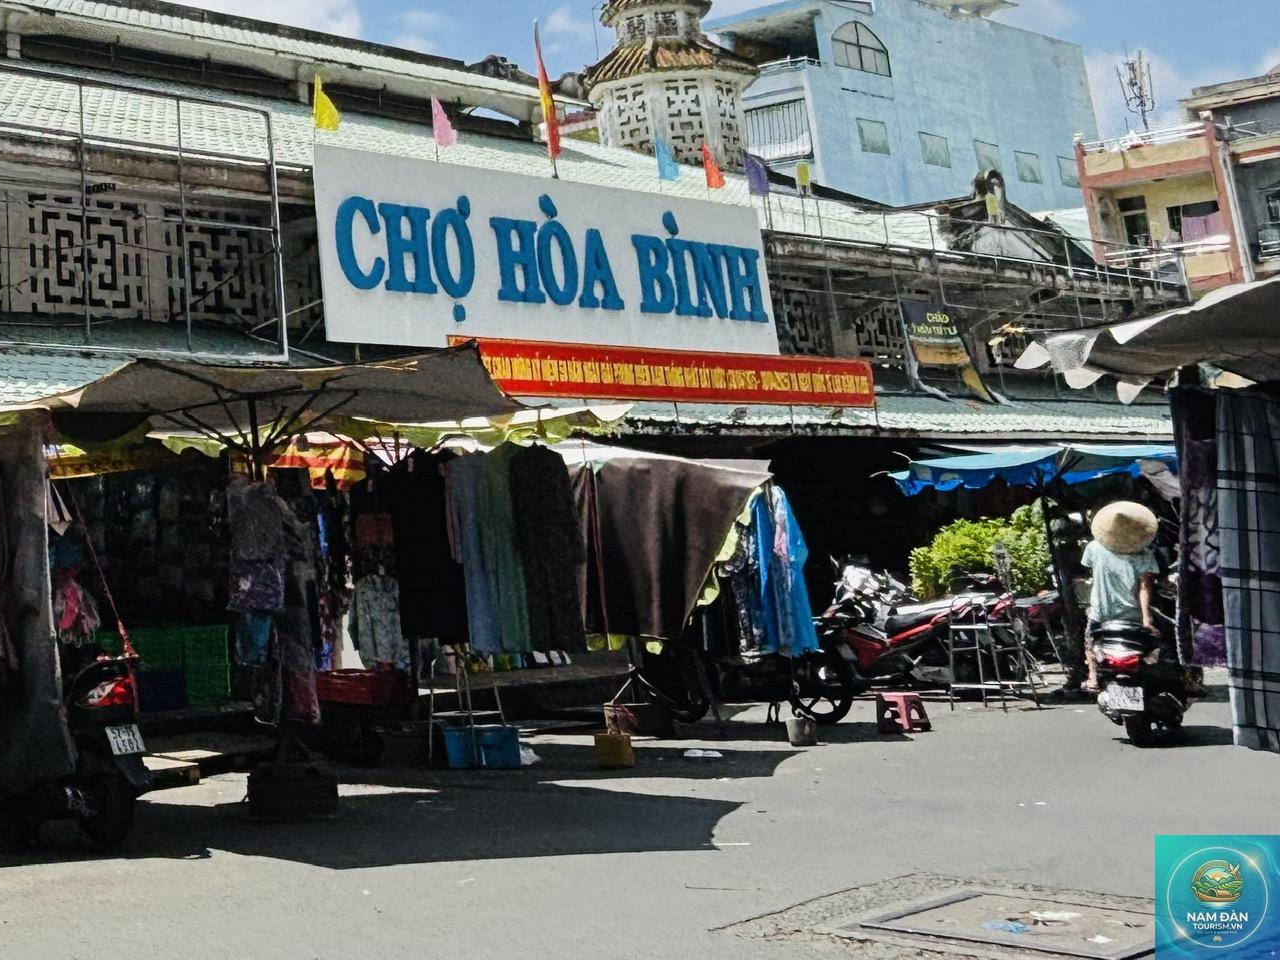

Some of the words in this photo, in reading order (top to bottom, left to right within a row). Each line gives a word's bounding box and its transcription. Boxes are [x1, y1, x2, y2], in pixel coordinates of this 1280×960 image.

[335, 195, 475, 323] CHỢ
[489, 193, 624, 310] HÒA
[631, 210, 768, 323] BÌNH
